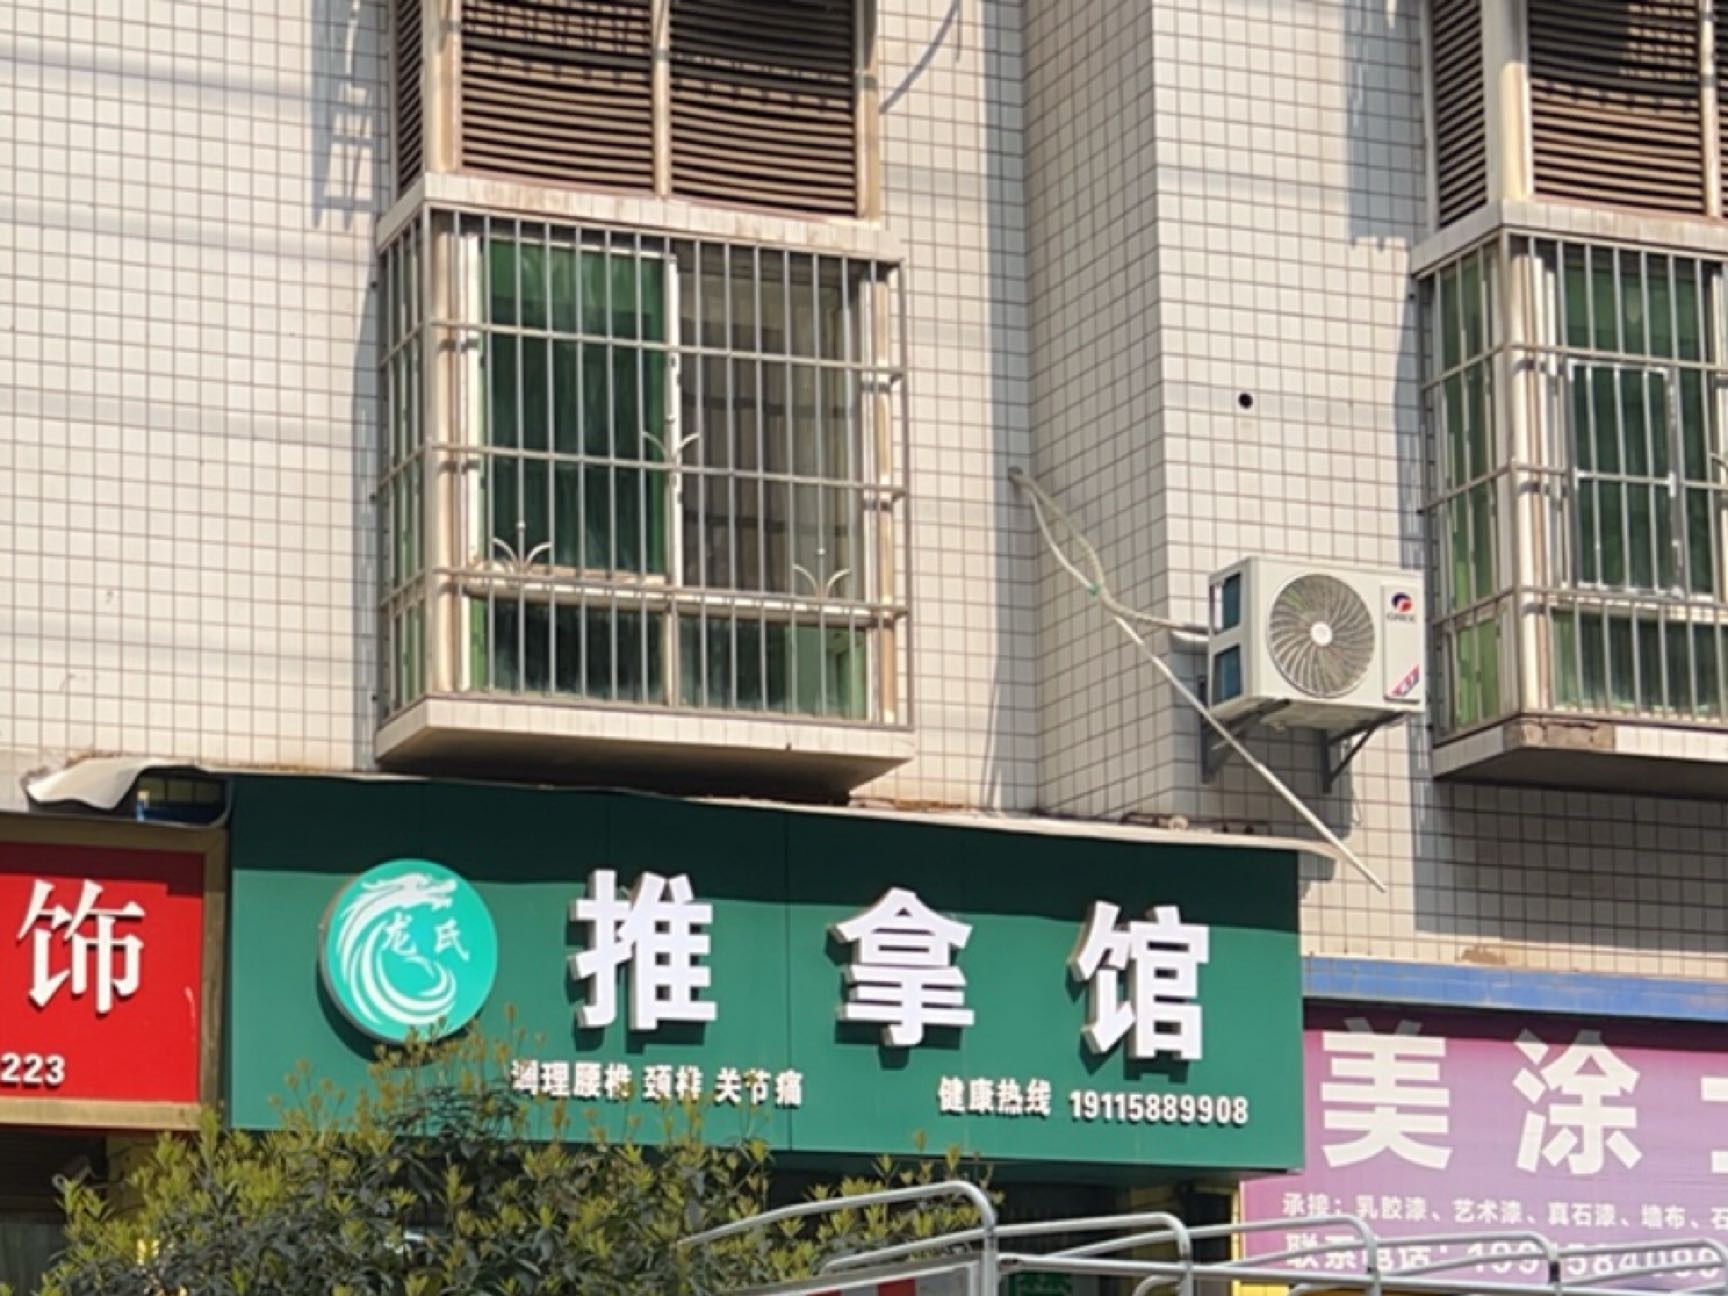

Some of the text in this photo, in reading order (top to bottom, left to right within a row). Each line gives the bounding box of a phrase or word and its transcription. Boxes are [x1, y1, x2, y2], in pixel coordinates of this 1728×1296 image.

[569, 868, 1210, 1061] 推拿馆
[938, 1076, 1249, 1125] 健康热线 19115889908
[1319, 1016, 1728, 1175] 美涂
